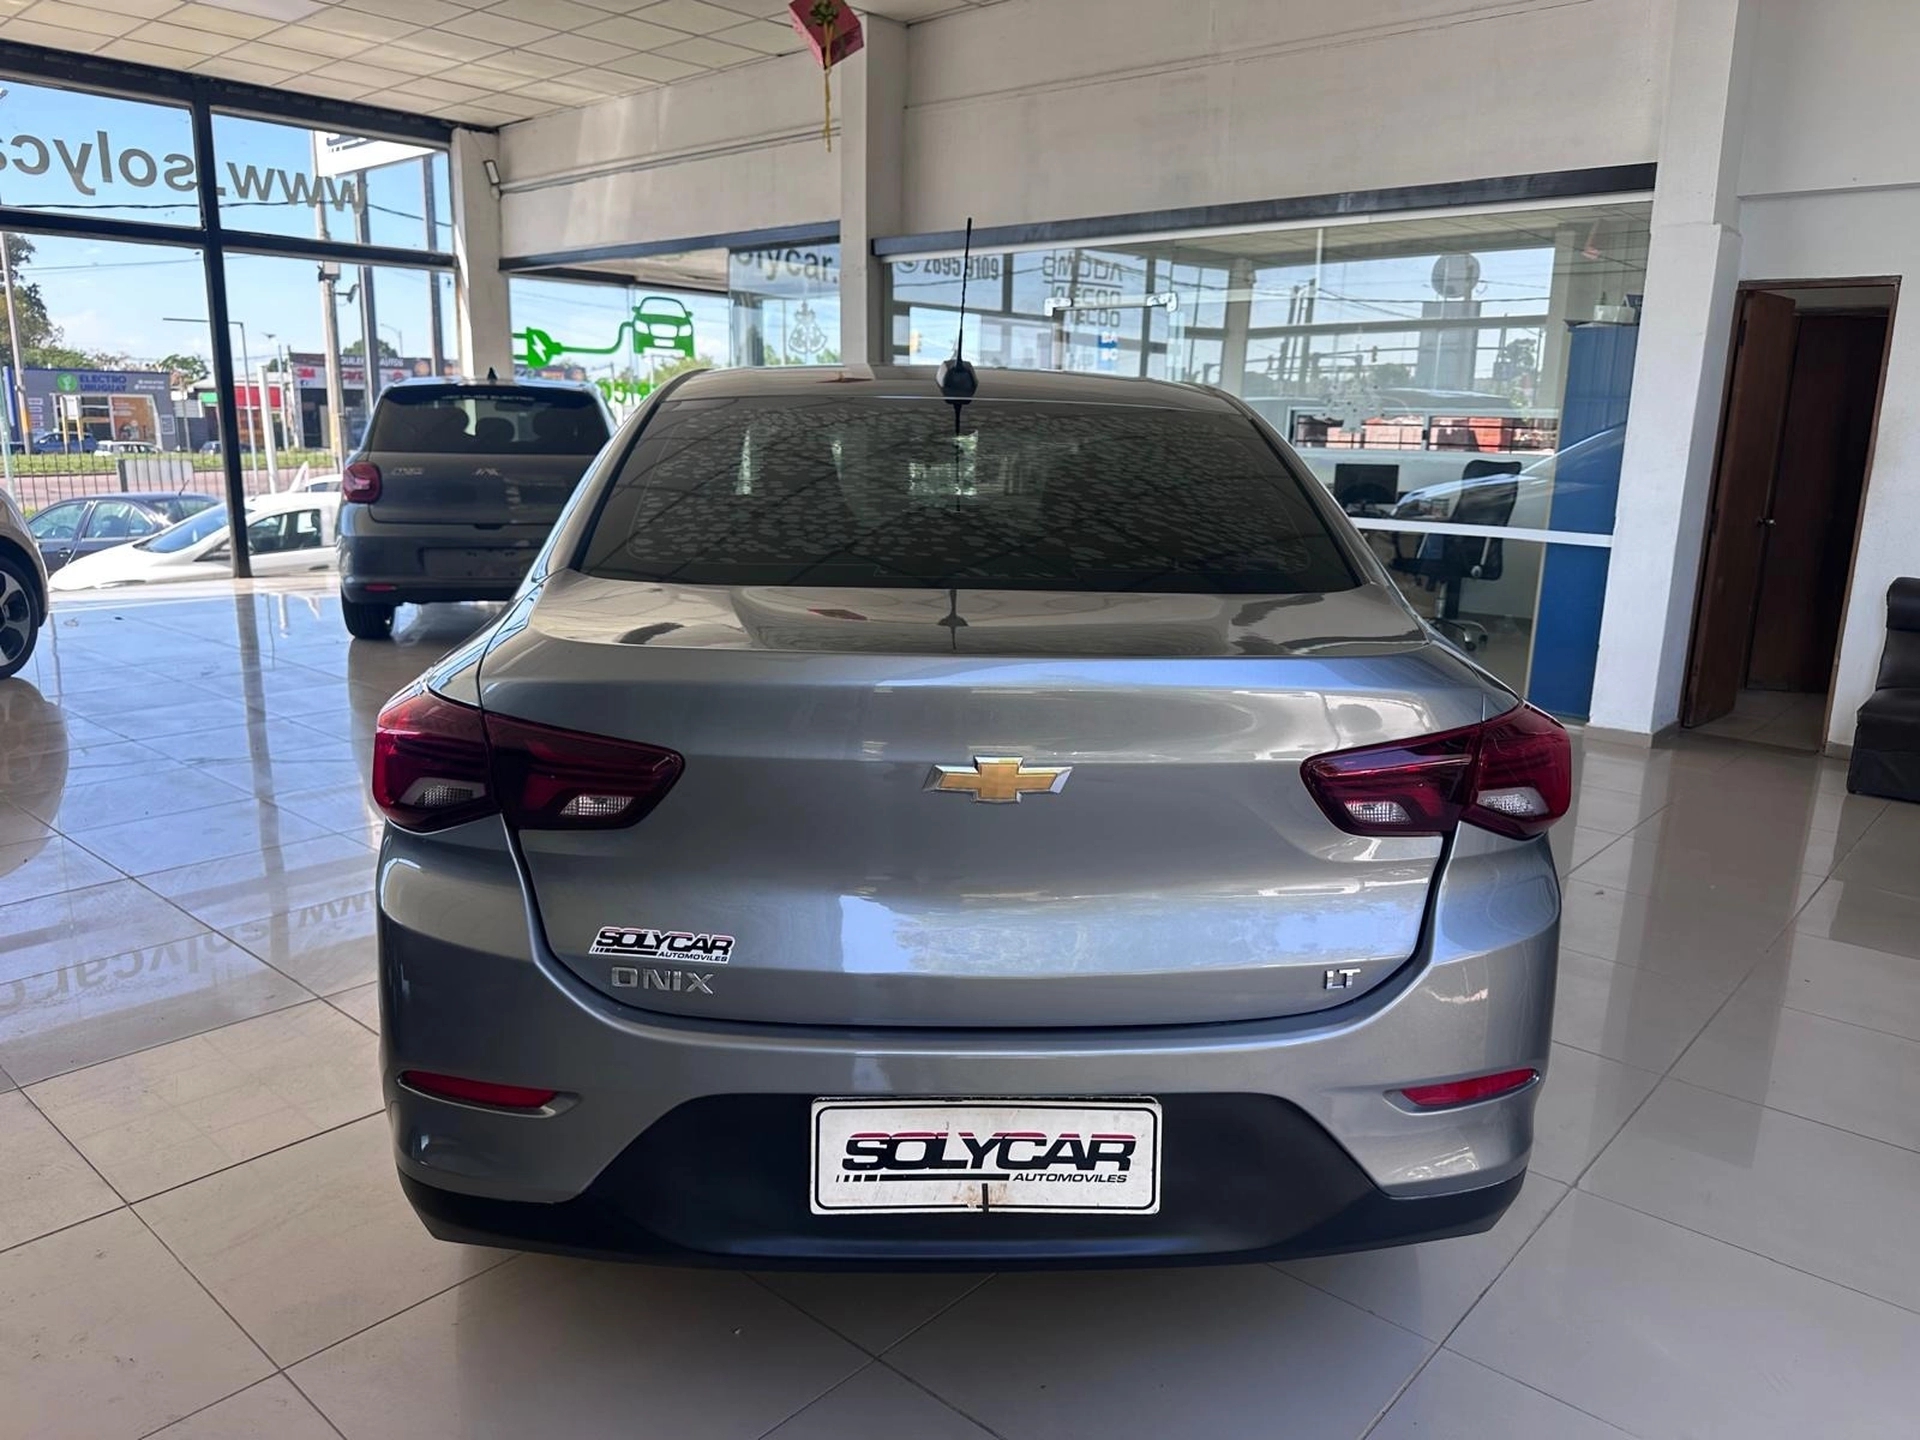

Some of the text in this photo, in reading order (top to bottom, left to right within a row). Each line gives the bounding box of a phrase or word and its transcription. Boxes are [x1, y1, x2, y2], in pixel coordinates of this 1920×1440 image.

[79, 374, 127, 384] ELECTRO
[79, 383, 127, 392] URUGUAY
[595, 926, 734, 956] SOLYCAR
[657, 951, 728, 963] AUTOMOVILES
[611, 966, 714, 995] ONIX
[1325, 968, 1361, 990] LT
[841, 1131, 1137, 1172] SOLYCAR
[1012, 1172, 1128, 1184] AUTOMOVILES
